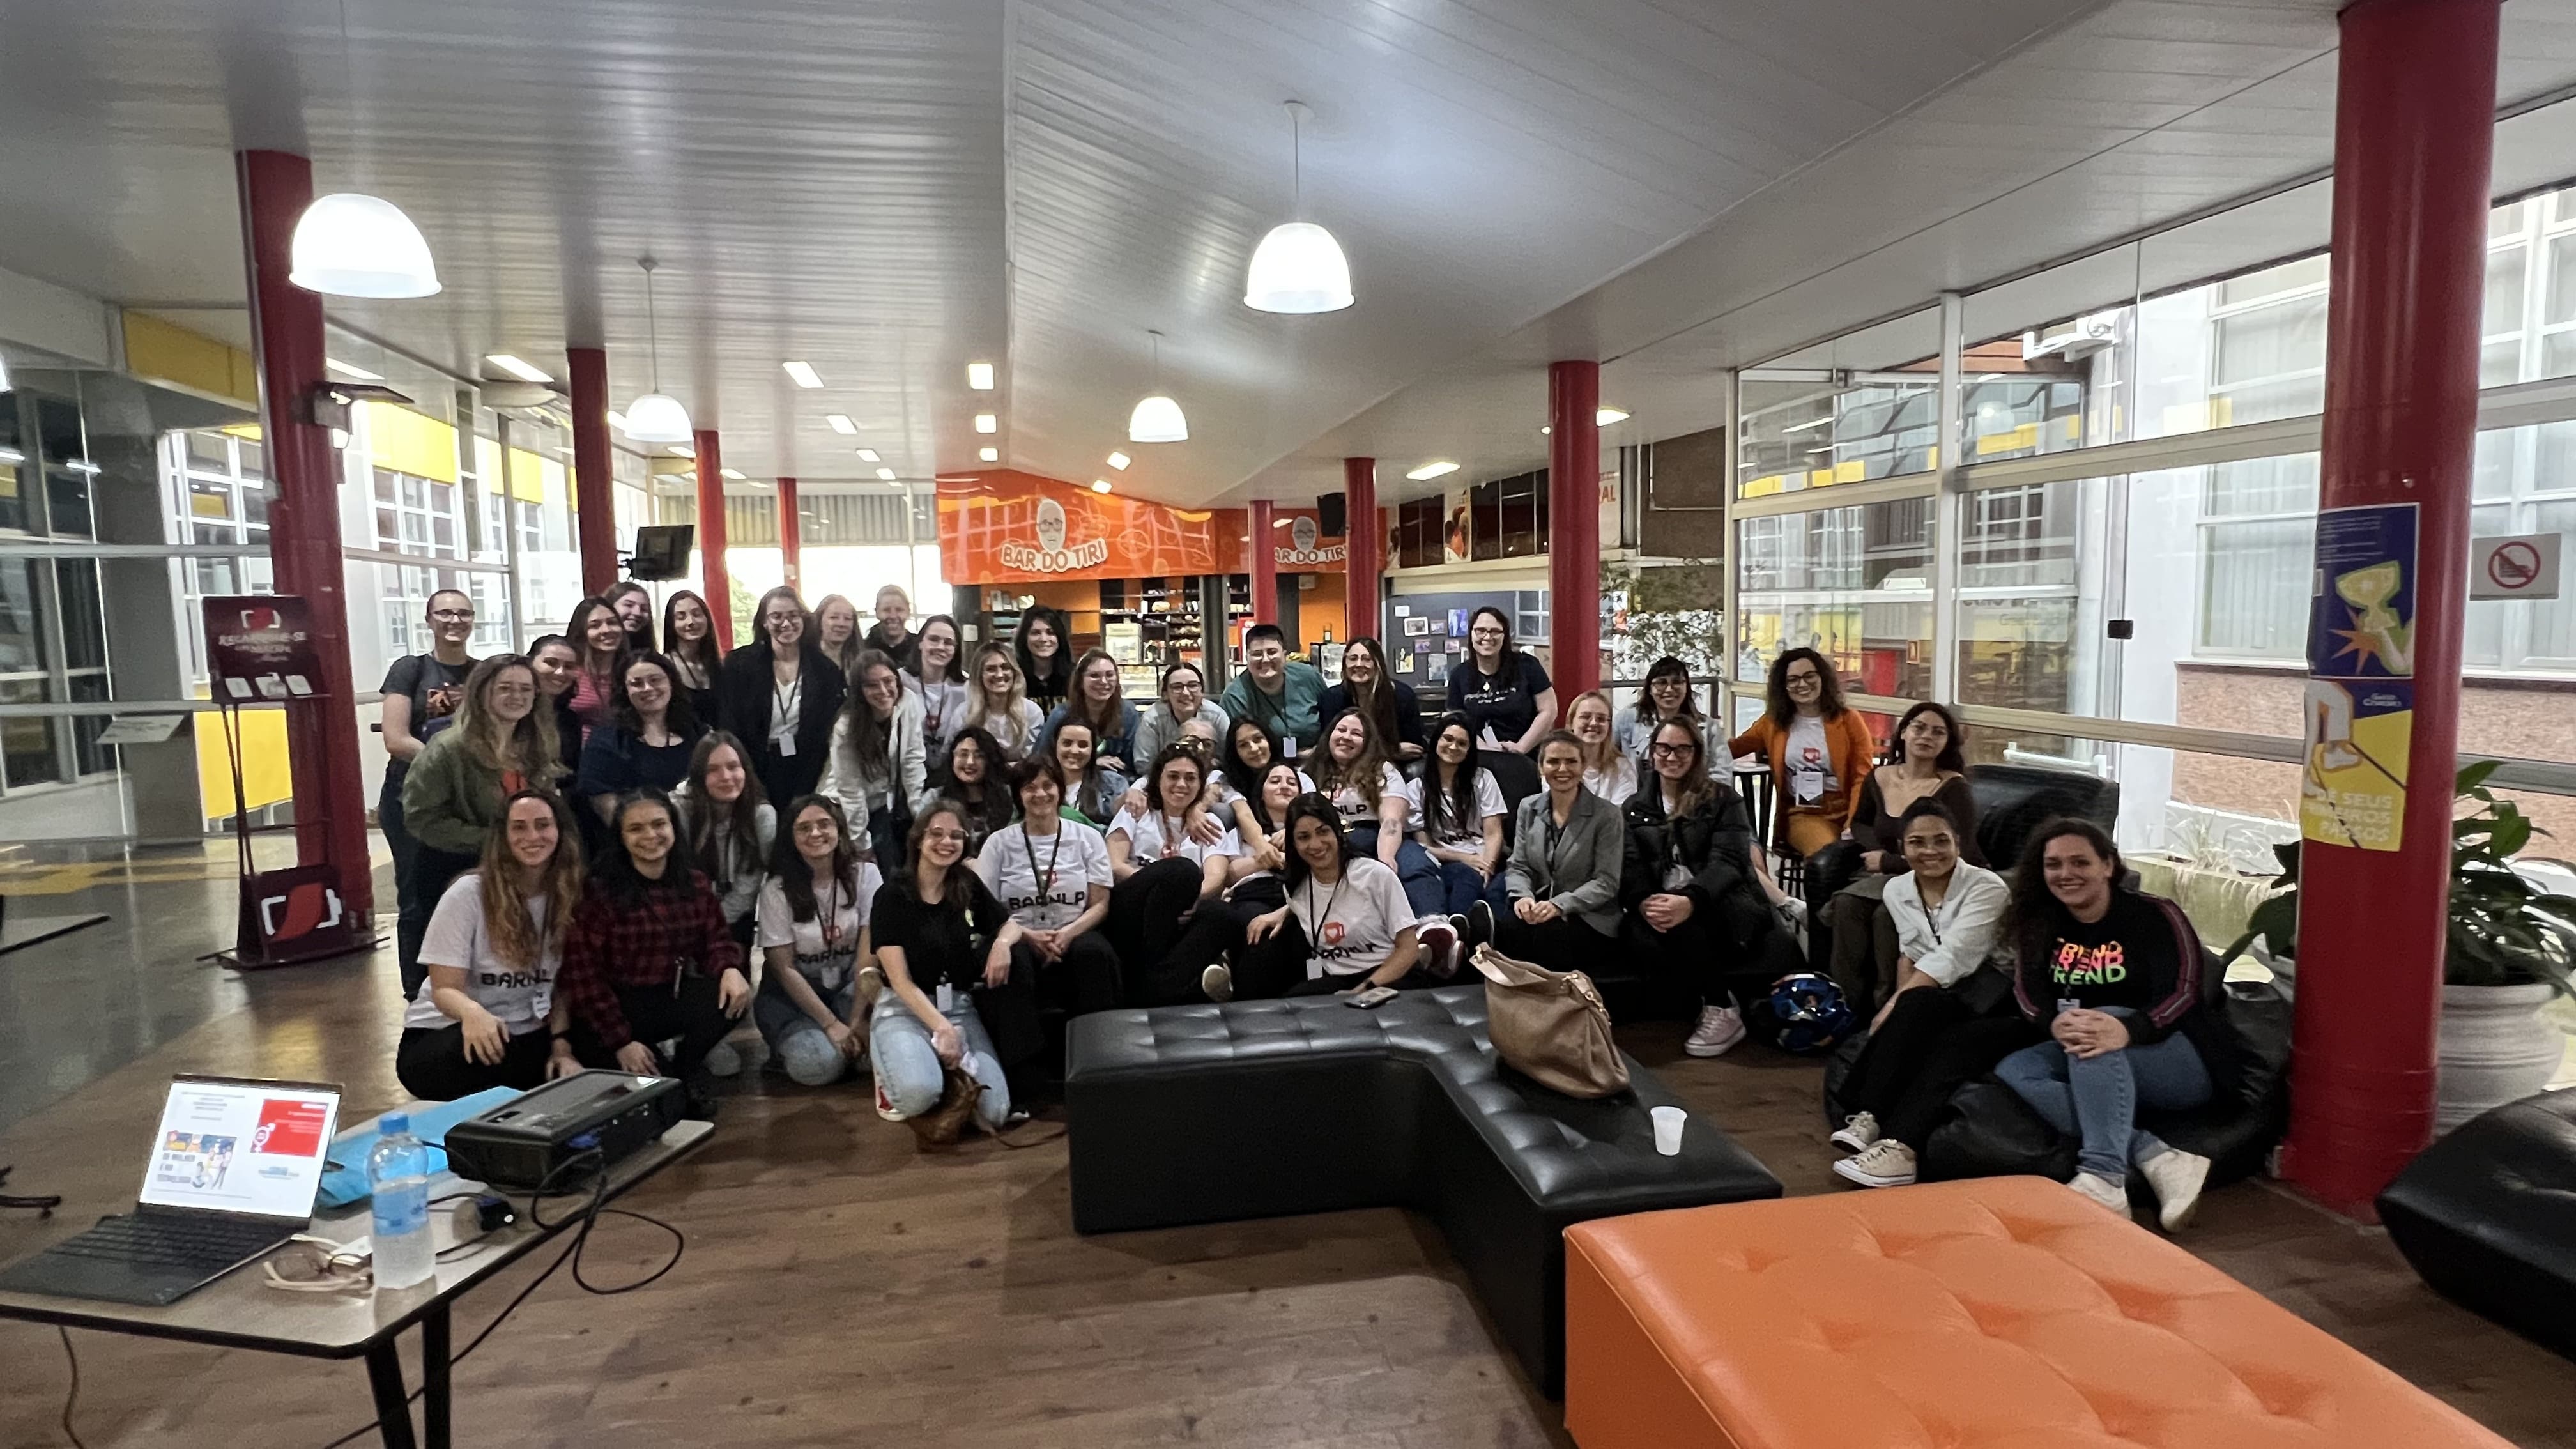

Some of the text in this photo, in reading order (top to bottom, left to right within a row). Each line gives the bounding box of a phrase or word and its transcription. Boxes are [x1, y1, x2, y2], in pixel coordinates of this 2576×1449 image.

[1600, 484, 1616, 504] AL
[1003, 540, 1105, 569] BAR DO TIRI
[1296, 551, 1318, 562] DO
[1009, 891, 1085, 910] BARNLP
[480, 969, 553, 989] BARNL
[2050, 964, 2126, 985] REND
